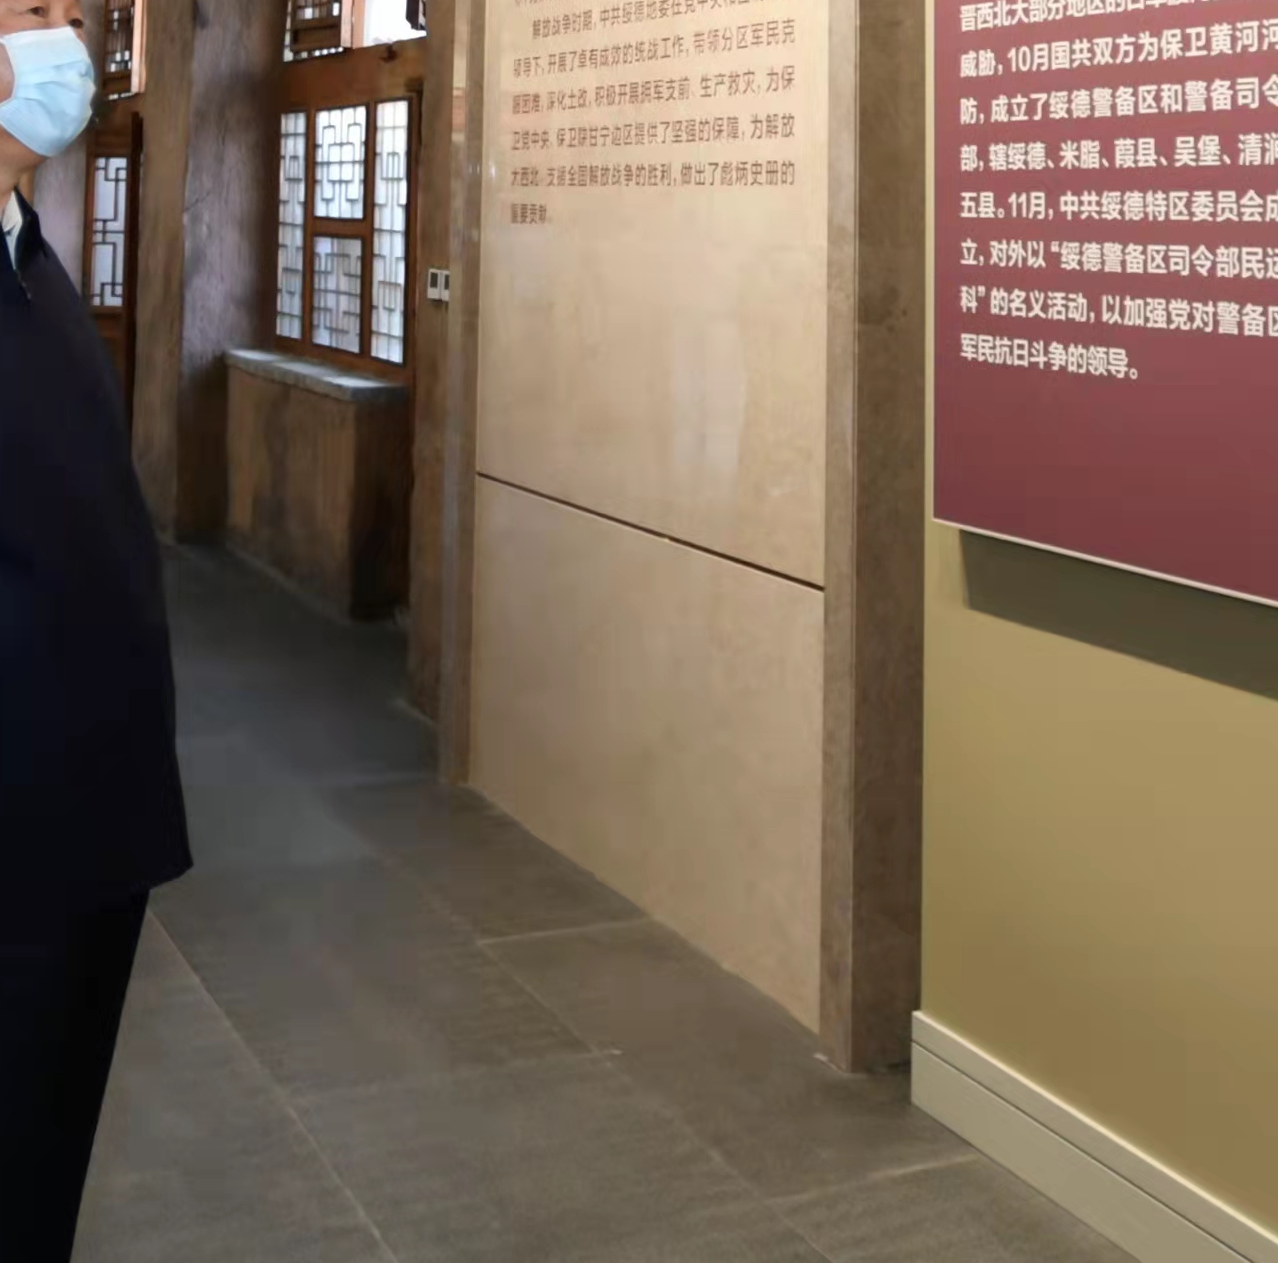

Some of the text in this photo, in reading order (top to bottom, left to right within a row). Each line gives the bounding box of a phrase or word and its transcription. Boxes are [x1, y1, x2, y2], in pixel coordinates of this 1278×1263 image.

[960, 333, 1138, 380] 军民抗日斗争的领导。
